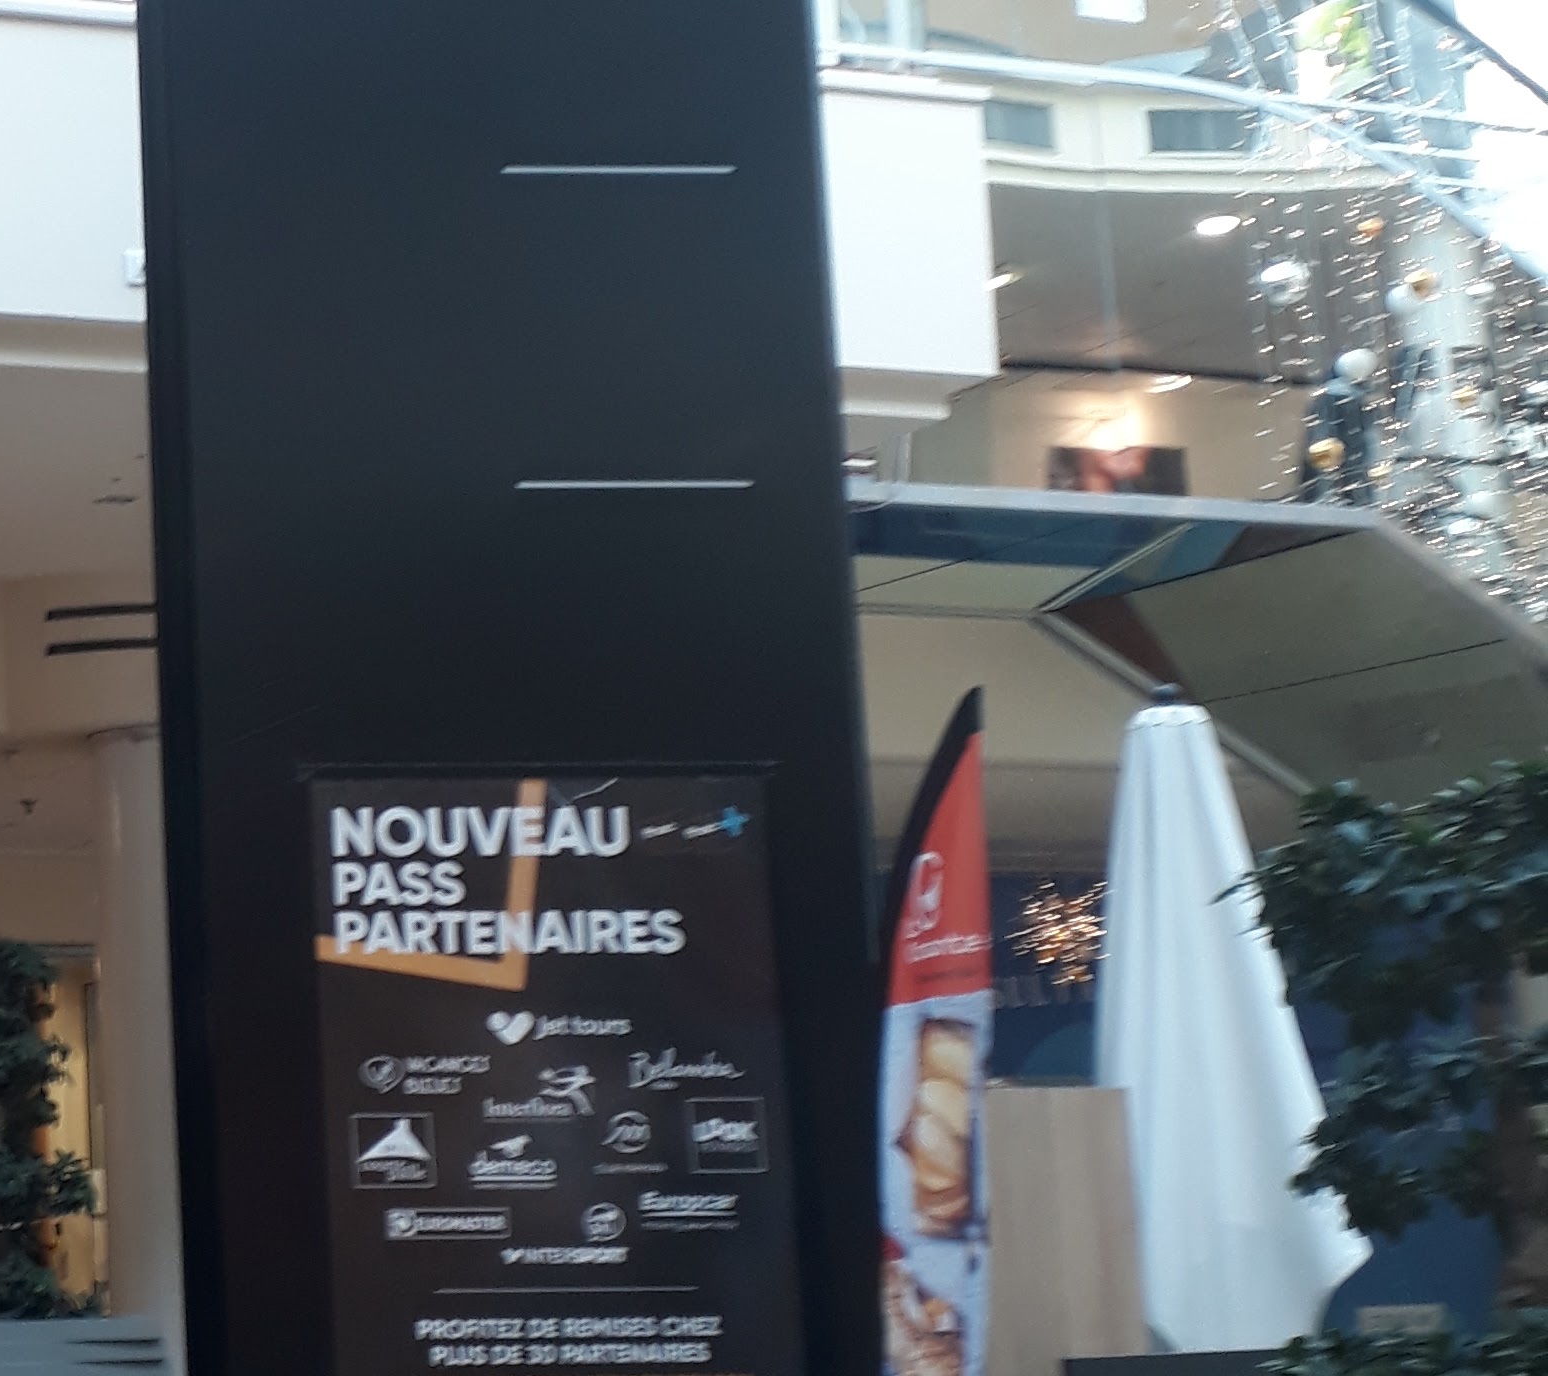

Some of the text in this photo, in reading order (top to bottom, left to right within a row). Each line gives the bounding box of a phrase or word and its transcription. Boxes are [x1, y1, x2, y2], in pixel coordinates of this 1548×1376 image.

[330, 805, 632, 858] NOUVEAU
[331, 861, 467, 907] PASS
[333, 908, 688, 956] PARTENAIRES
[414, 1314, 724, 1340] PROFITEZ DE REMISES CHEZ
[428, 1343, 489, 1367] PLUS
[490, 1343, 524, 1365] DE
[558, 1341, 713, 1365] PARTENAIRES
